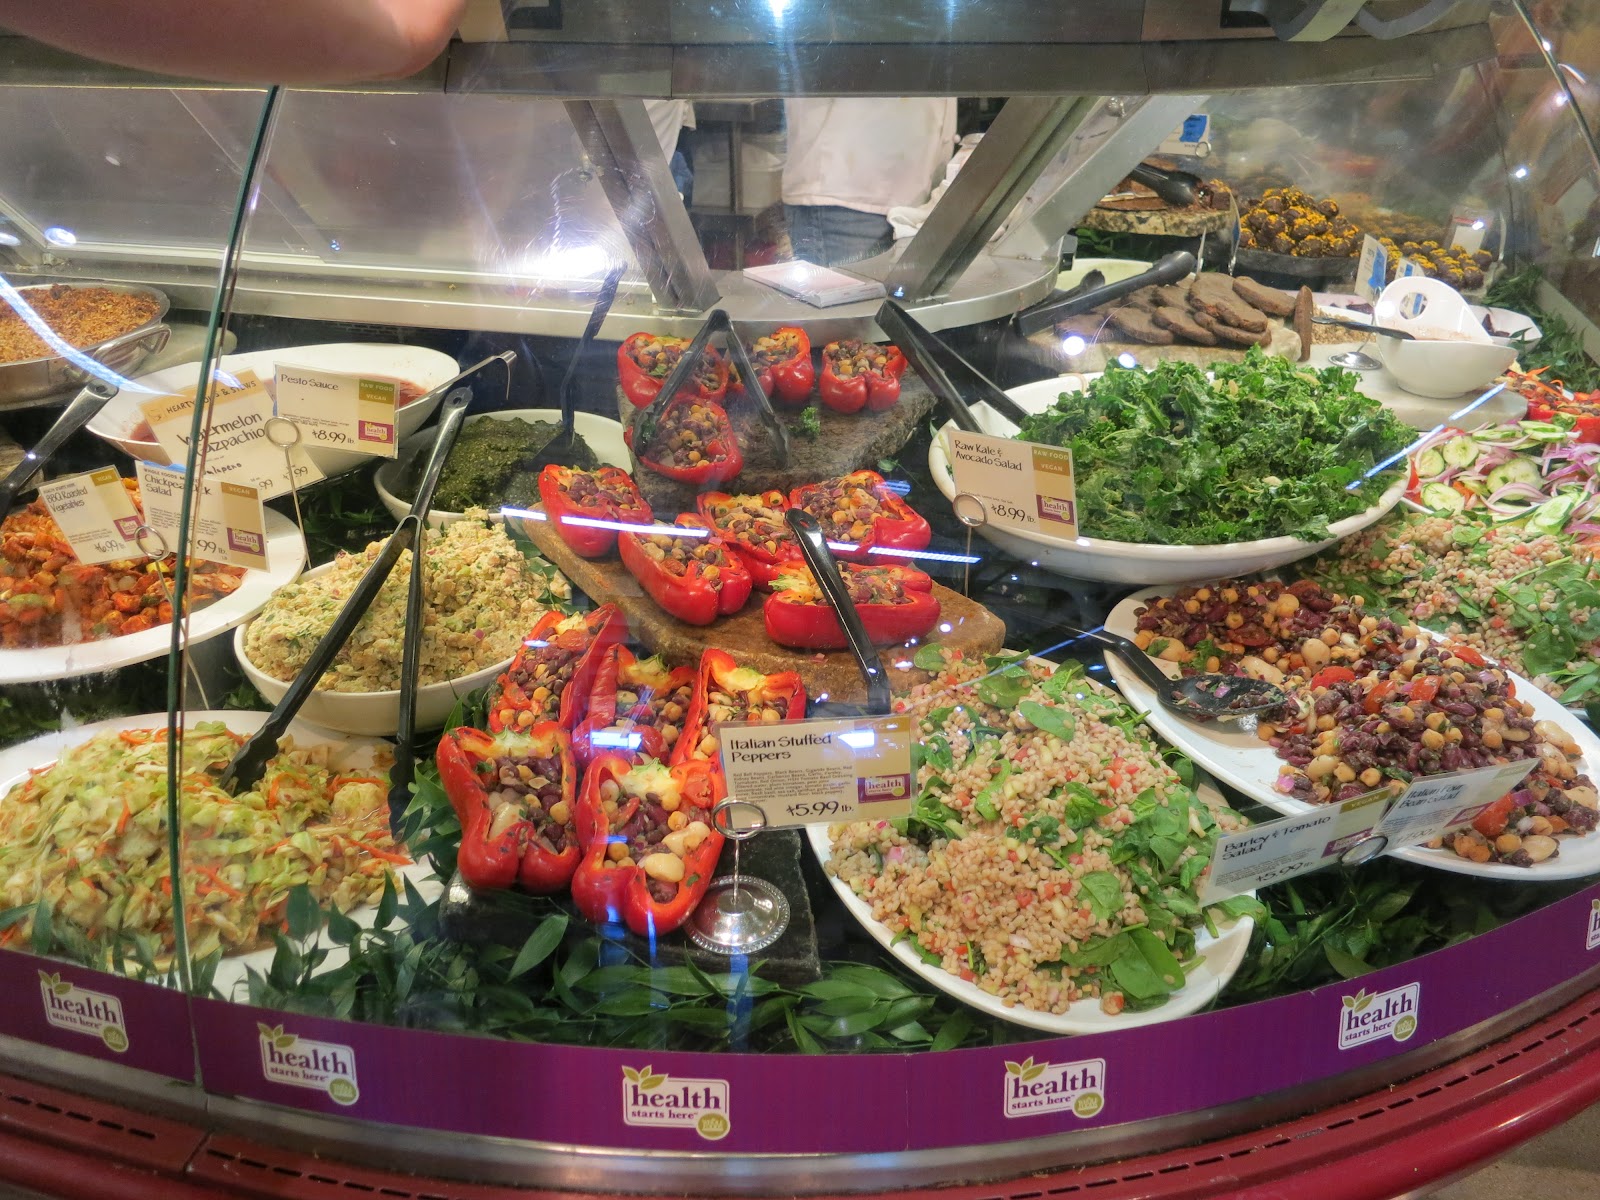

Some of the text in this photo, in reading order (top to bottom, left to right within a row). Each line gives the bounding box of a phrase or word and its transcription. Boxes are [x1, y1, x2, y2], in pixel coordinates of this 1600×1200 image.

[281, 373, 339, 391] Pesto Sauce
[365, 393, 387, 401] VEGAN
[312, 429, 347, 444] $8.99
[366, 426, 387, 435] health
[954, 439, 975, 452] Raw
[975, 444, 996, 456] Kale
[1034, 449, 1069, 460] RAW FOOD
[955, 451, 1022, 472] Avocado Salad
[1040, 463, 1063, 472] VEGAN
[46, 486, 88, 503] BBQ Roasted
[145, 483, 172, 497] Salad
[228, 486, 250, 495] VEGAN
[50, 499, 85, 513] Vegetables
[991, 503, 1026, 522] $8.99
[1044, 500, 1067, 512] health
[234, 533, 257, 544] health
[730, 733, 832, 751] Italian Stuffed
[731, 751, 791, 763] Peppers
[868, 779, 902, 790] health
[1406, 786, 1440, 799] Italian
[786, 801, 855, 817] $5.99 lb.
[1350, 794, 1380, 809] VEGAN
[1398, 797, 1428, 809] Bean
[1223, 833, 1269, 853] Barley
[1282, 816, 1331, 837] Tomato
[1222, 844, 1264, 861] Salad
[48, 988, 118, 1024] health
[1345, 992, 1412, 1031] health
[51, 1011, 100, 1029] starts here
[1344, 1029, 1370, 1041] starts
[1373, 1022, 1392, 1033] here
[267, 1041, 348, 1075] health
[270, 1067, 326, 1081] starts here
[1012, 1068, 1097, 1099] health
[631, 1084, 721, 1109] health
[1012, 1099, 1044, 1109] starts
[1046, 1096, 1071, 1105] here
[631, 1109, 695, 1119] starts here
